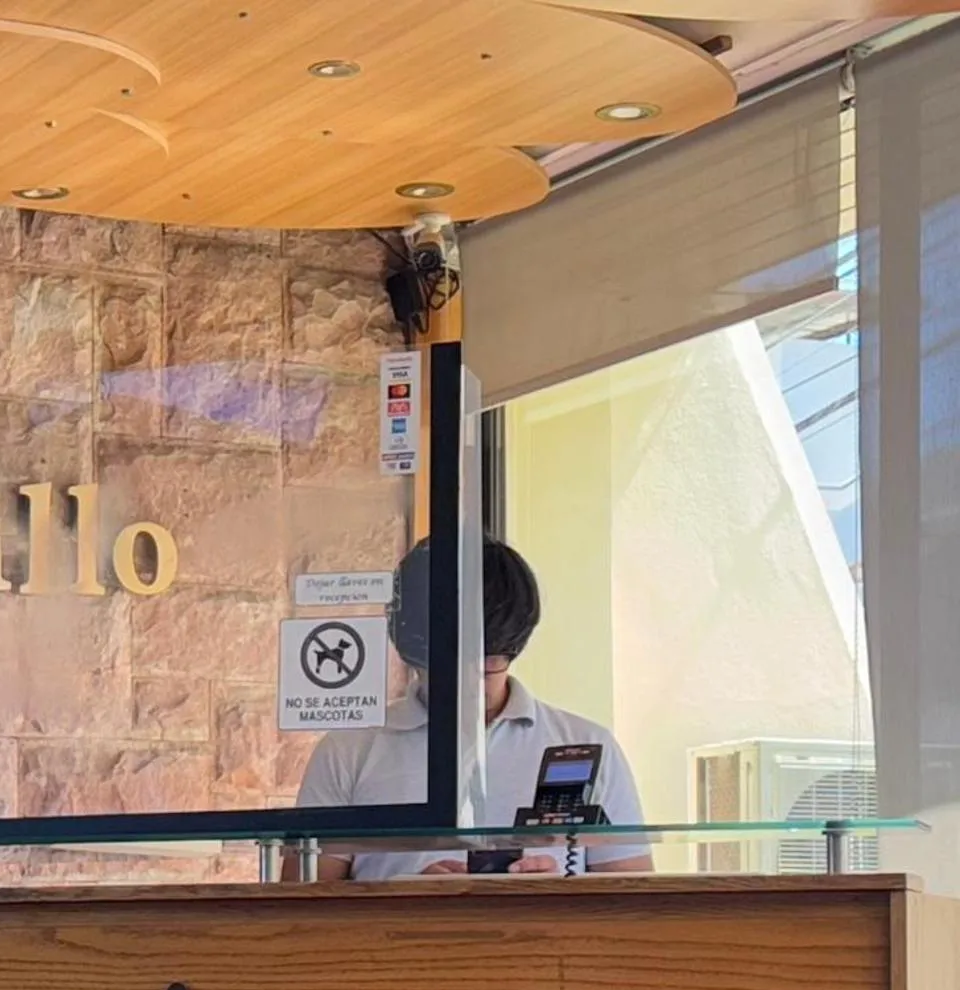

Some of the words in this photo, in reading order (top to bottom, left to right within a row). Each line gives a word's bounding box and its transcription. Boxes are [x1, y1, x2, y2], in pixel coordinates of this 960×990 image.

[286, 697, 302, 709] NO
[305, 697, 321, 708] SE
[323, 696, 378, 708] ACEPTAN
[299, 710, 364, 722] MASCOTAS
